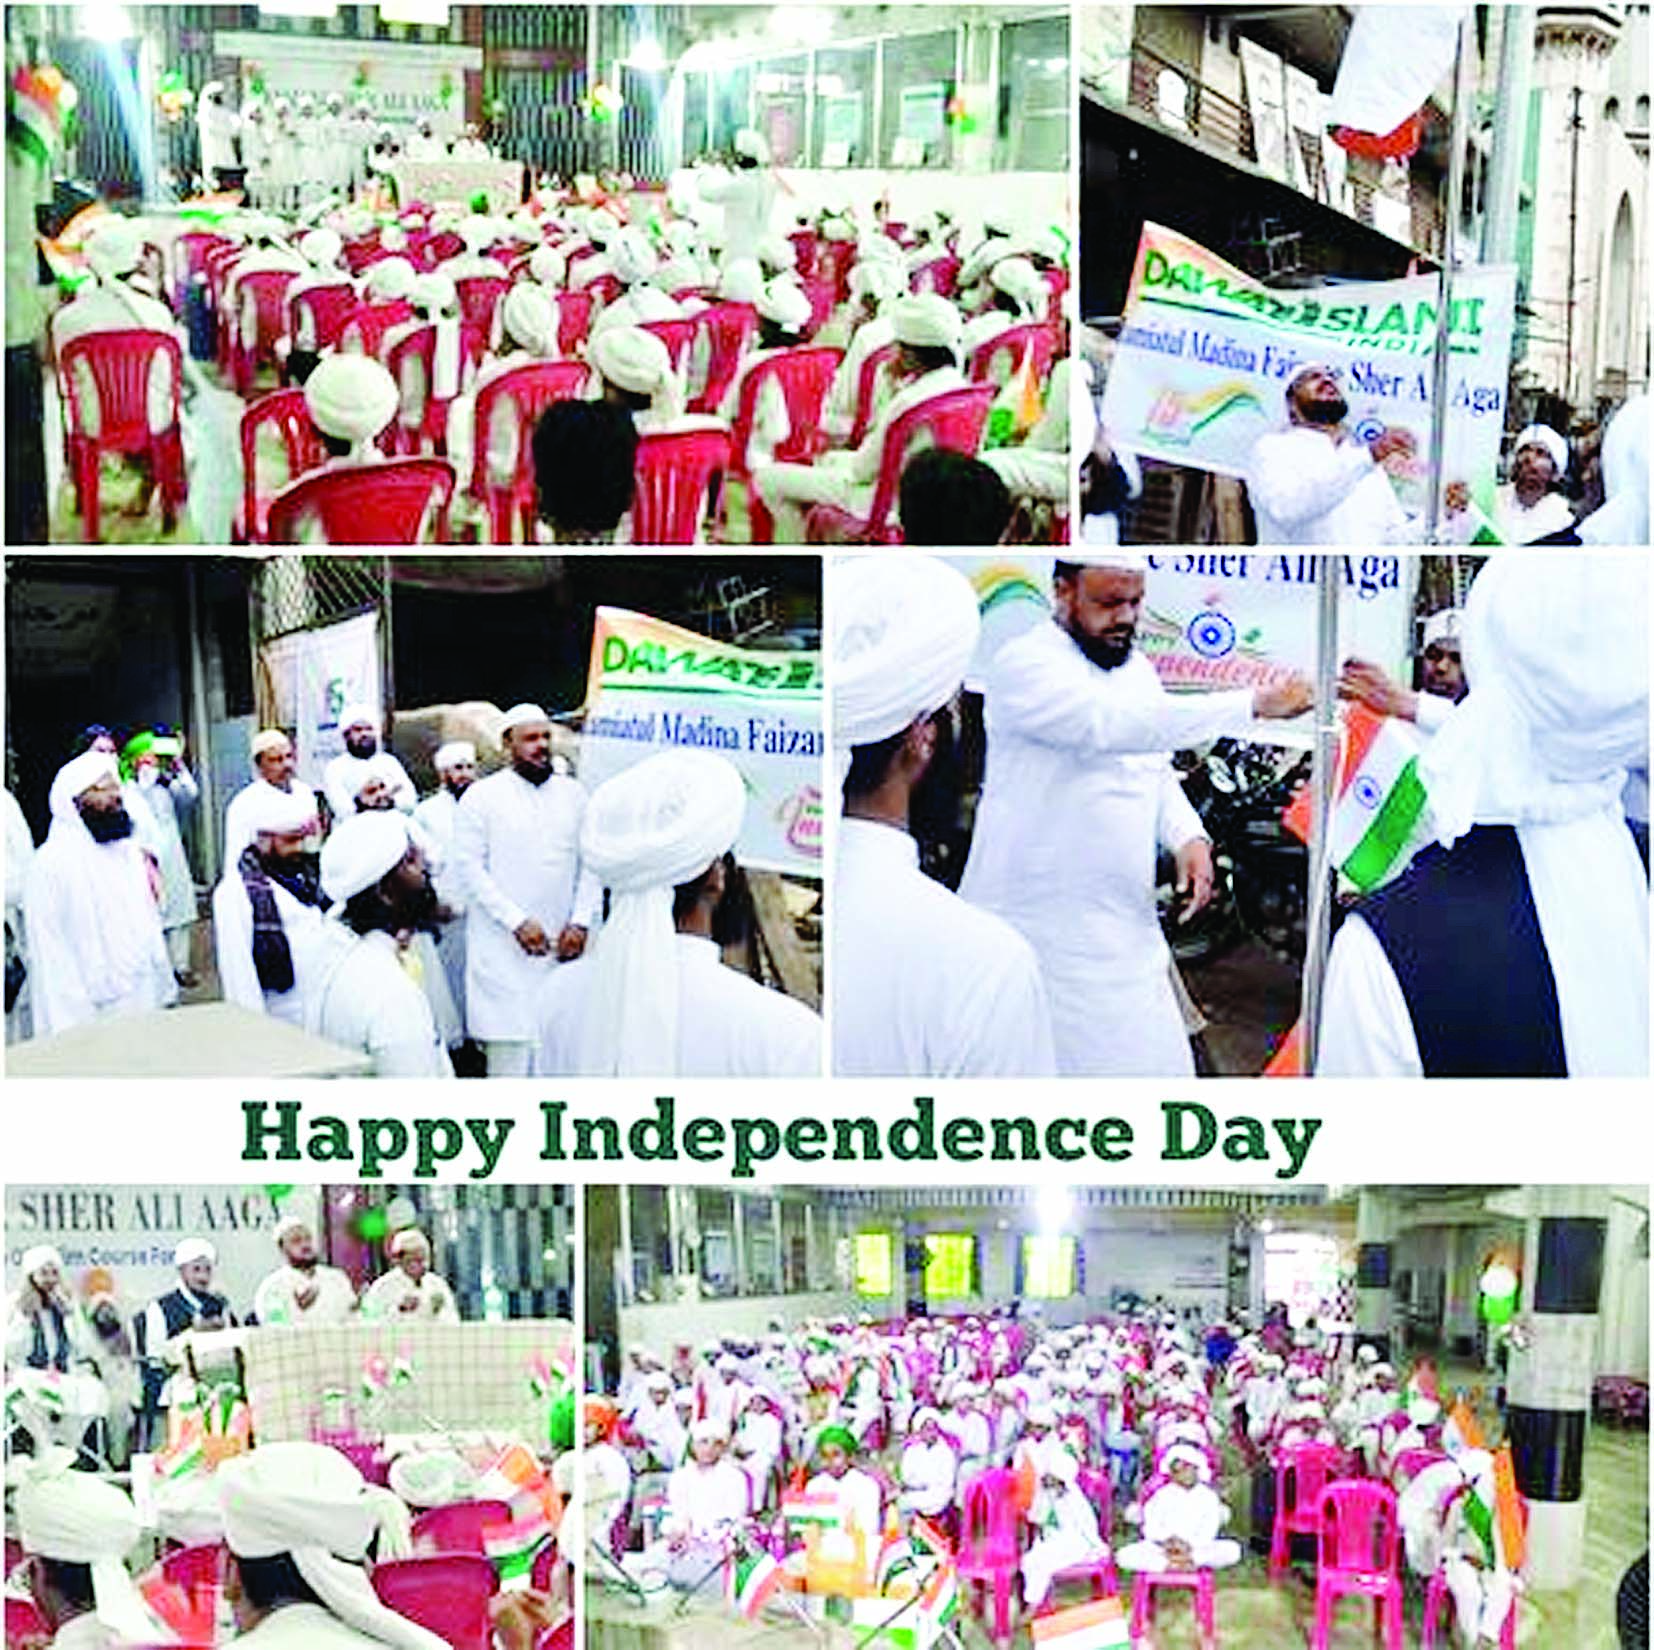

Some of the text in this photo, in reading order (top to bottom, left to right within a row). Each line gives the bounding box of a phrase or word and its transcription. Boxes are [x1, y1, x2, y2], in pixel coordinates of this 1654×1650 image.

[1350, 362, 1404, 397] Sher
[1453, 376, 1500, 417] Aga
[661, 712, 741, 751] Madina
[19, 1192, 116, 1231] SHER
[132, 1192, 184, 1231] ALI
